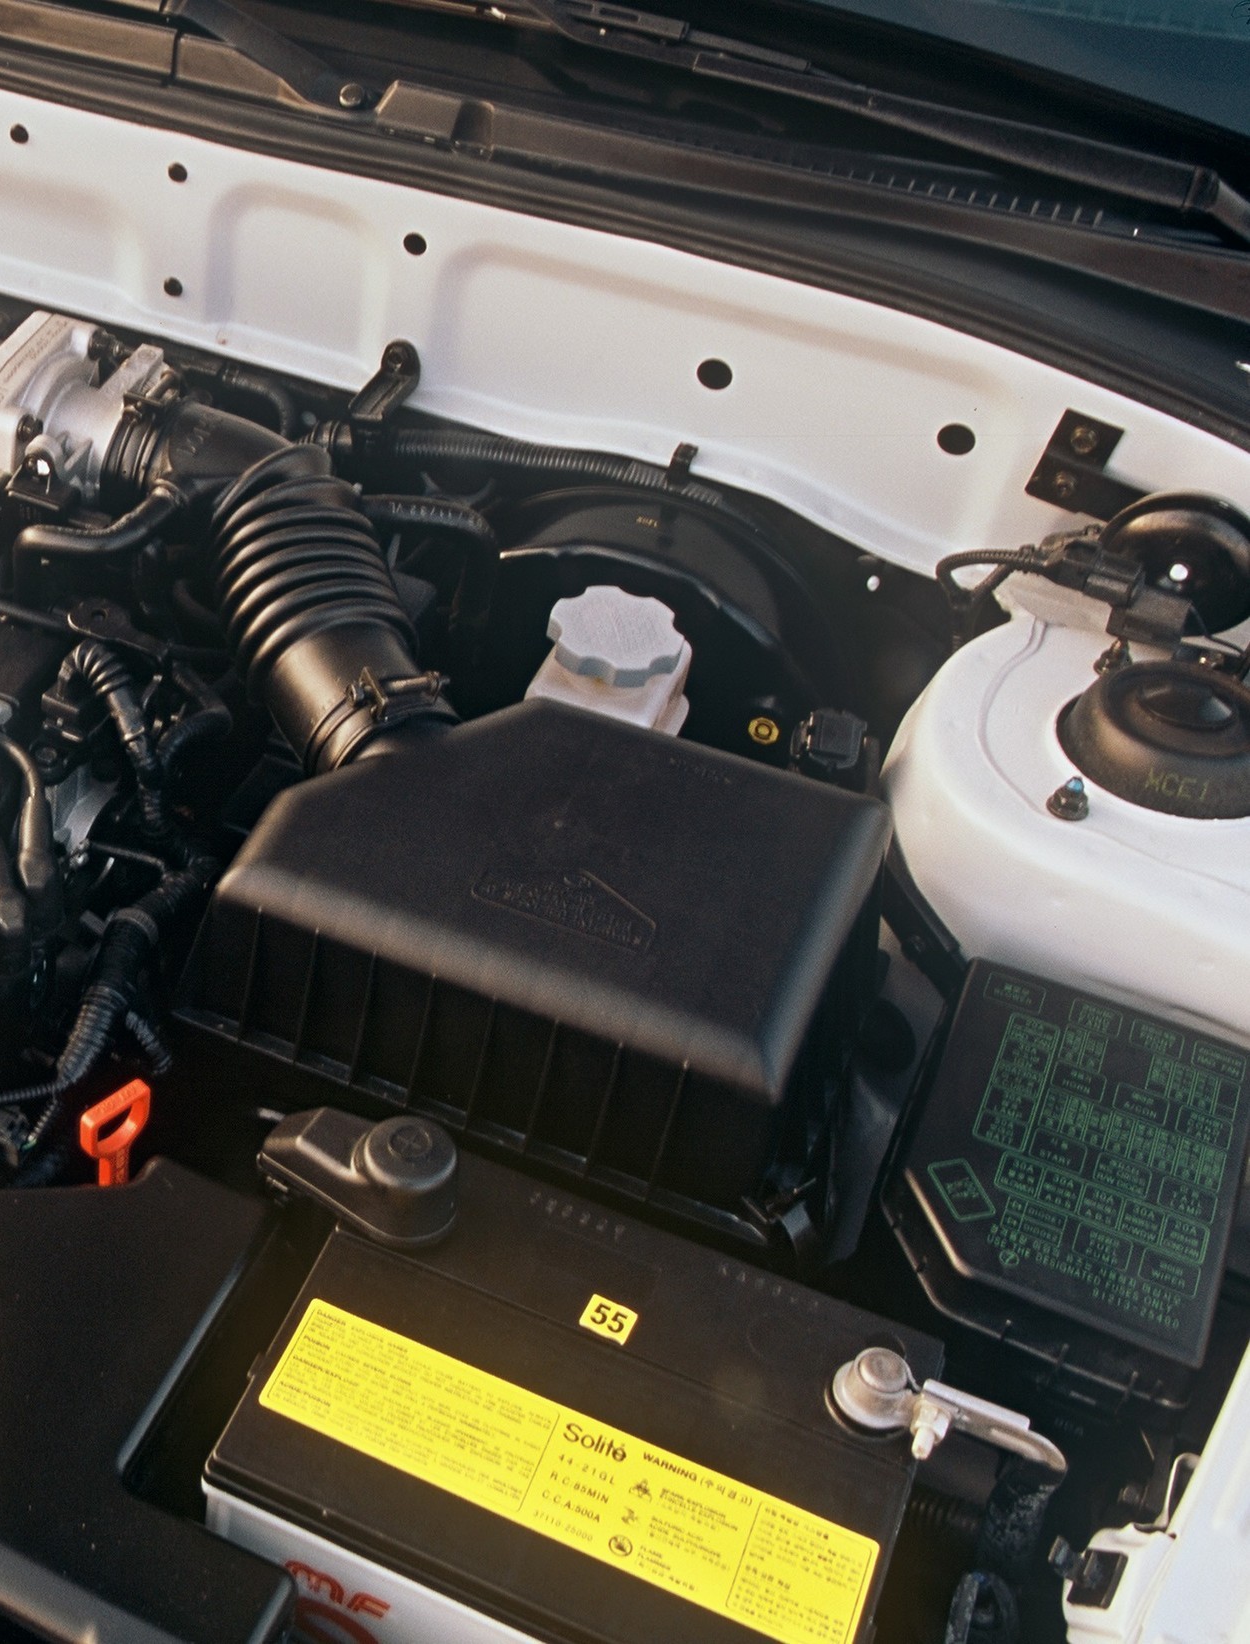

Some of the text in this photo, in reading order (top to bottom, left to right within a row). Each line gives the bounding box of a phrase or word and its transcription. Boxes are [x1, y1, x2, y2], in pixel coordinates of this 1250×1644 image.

[985, 1234, 1008, 1248] USE
[1010, 1243, 1031, 1258] THE
[1033, 1253, 1103, 1285] DESIGNATED
[1102, 1281, 1141, 1301] FUSES
[1141, 1294, 1174, 1313] ONLY
[590, 1303, 629, 1334] 55
[642, 1451, 698, 1482] WARNING
